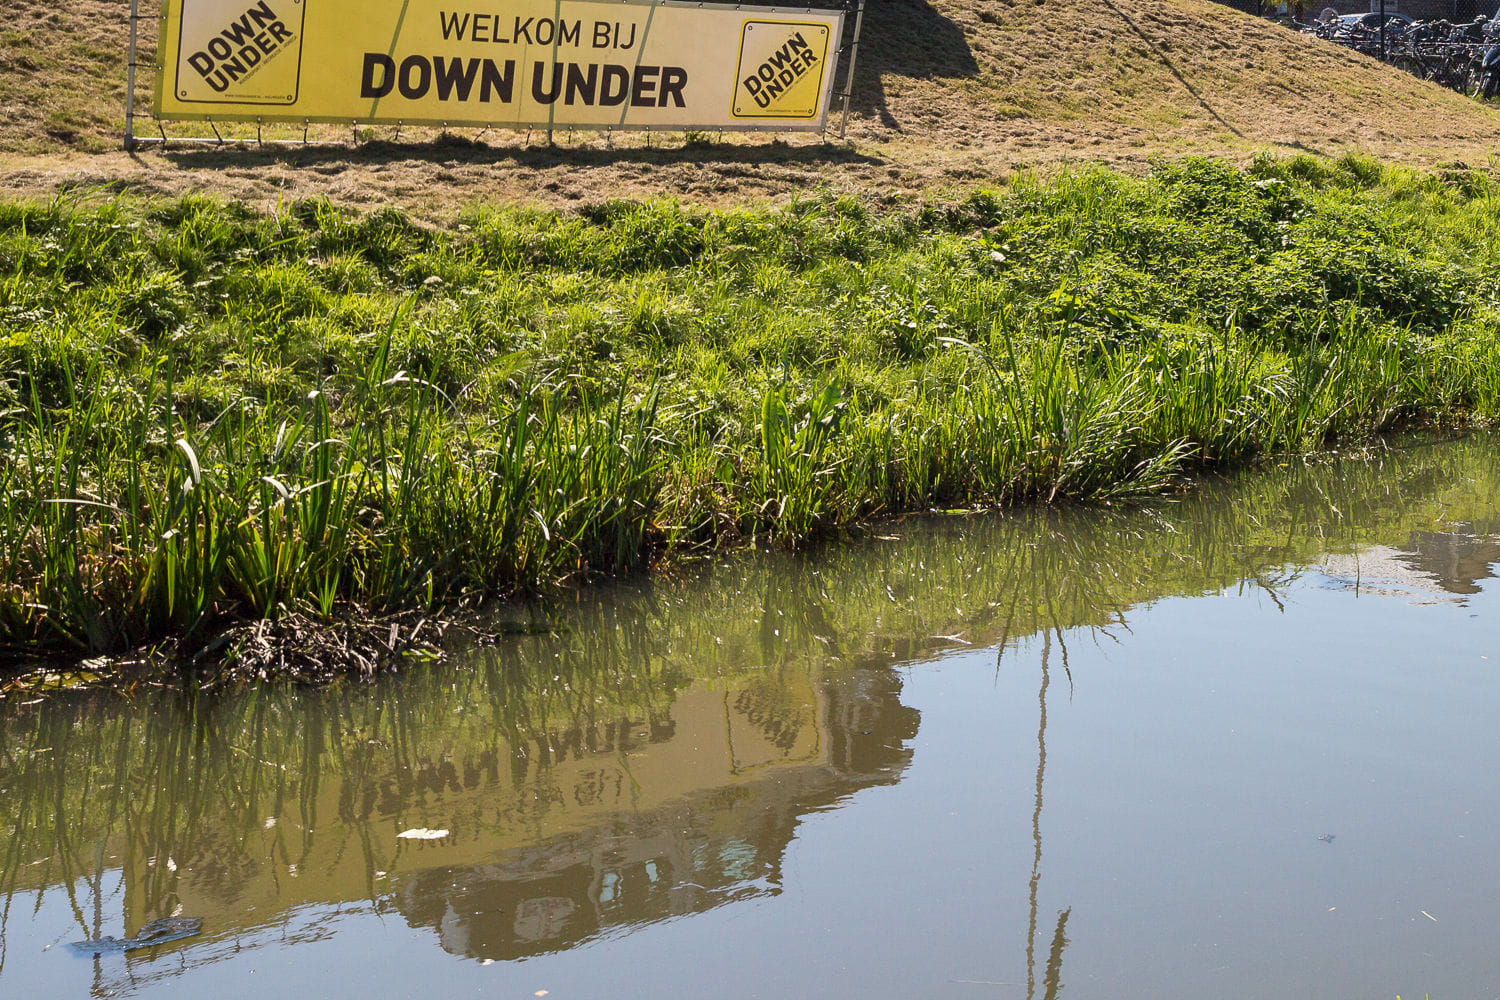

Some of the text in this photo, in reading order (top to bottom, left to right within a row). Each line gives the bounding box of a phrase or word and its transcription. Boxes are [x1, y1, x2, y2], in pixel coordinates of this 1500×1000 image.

[187, 0, 277, 77] DOWN
[205, 21, 293, 92] UNDER
[440, 11, 636, 49] WELKOM BIJ
[360, 52, 688, 108] DOWN UNDER
[743, 32, 808, 96] DOWN
[754, 49, 818, 108] UNDER
